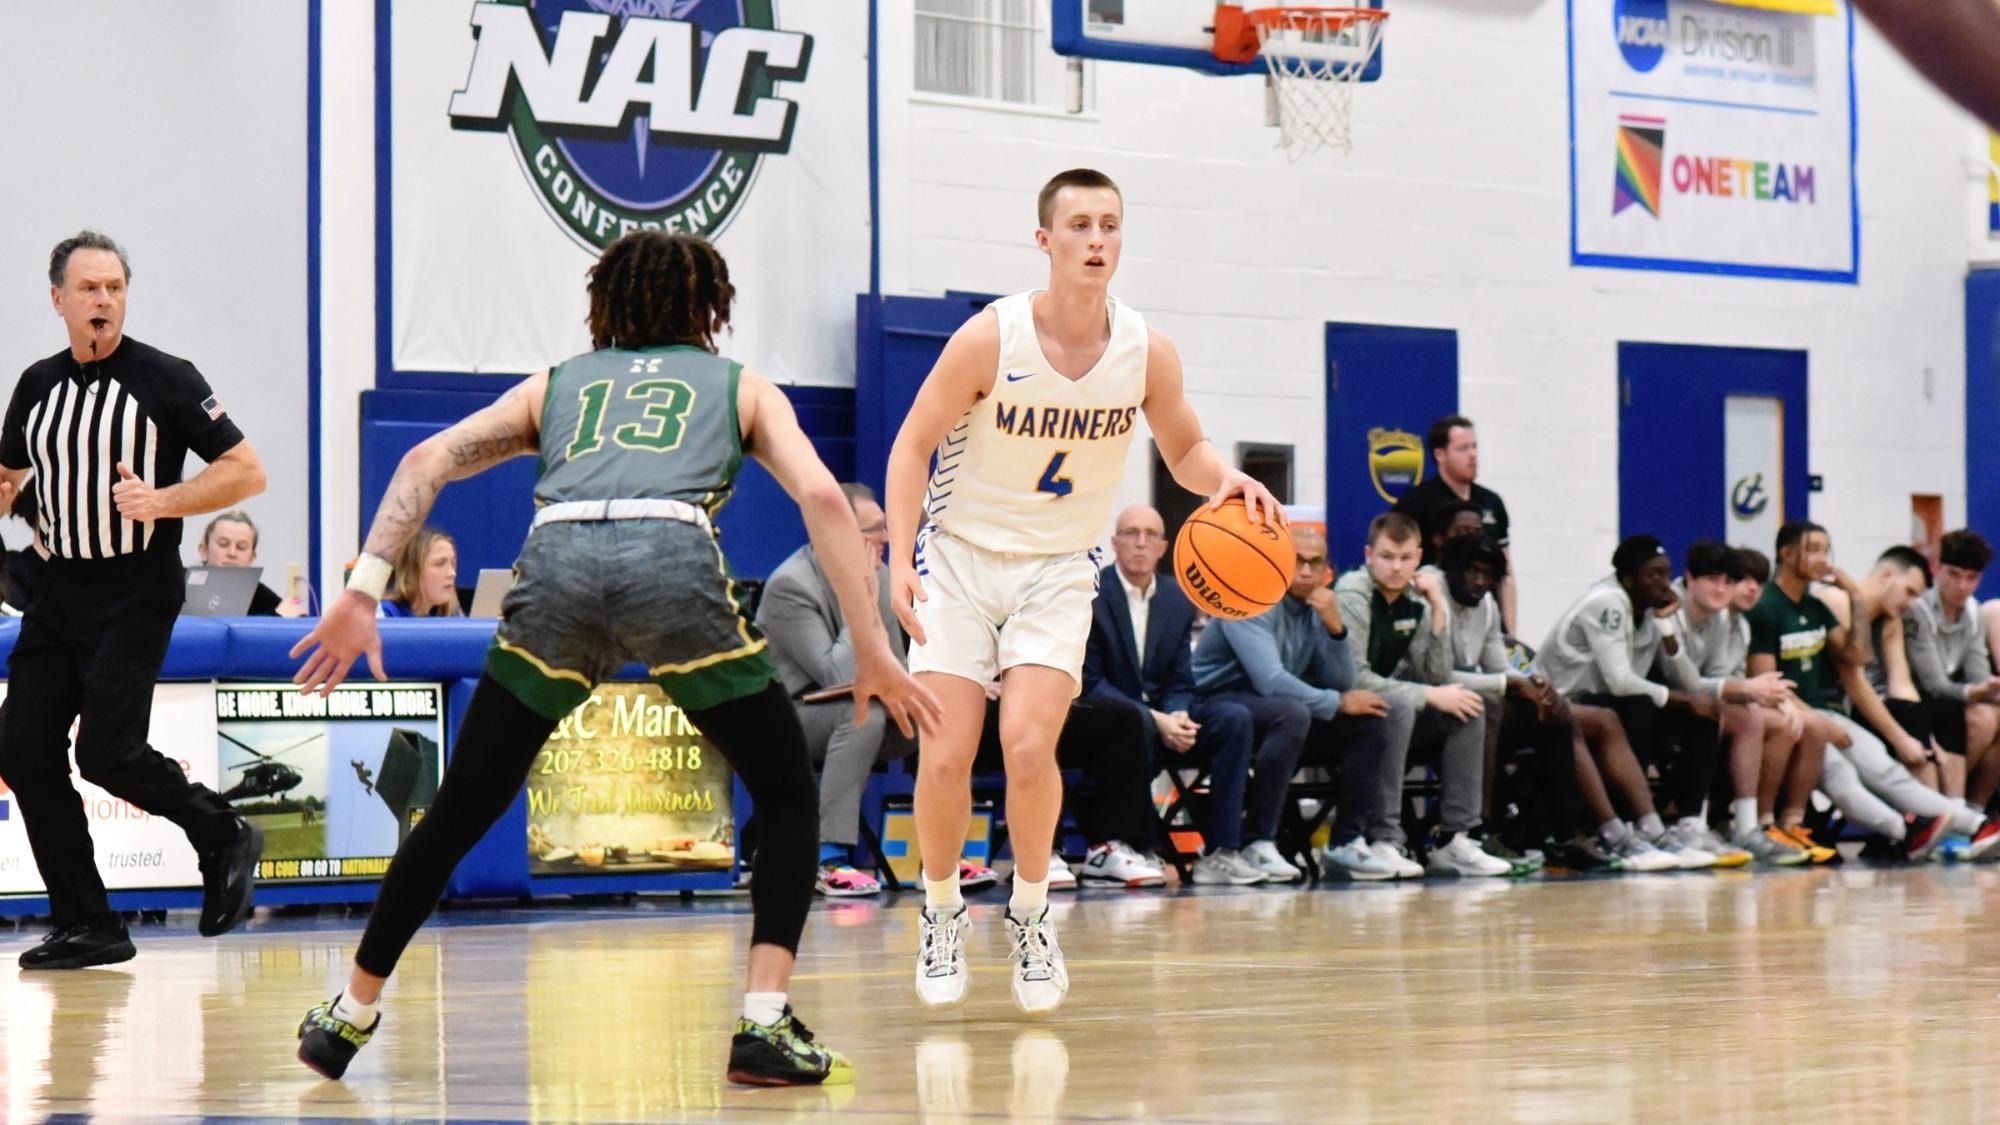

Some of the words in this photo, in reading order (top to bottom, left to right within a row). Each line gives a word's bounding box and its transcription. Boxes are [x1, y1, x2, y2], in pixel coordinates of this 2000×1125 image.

[1680, 14, 1772, 64] Division
[1777, 25, 1797, 67] III
[448, 1, 813, 154] NAC
[1672, 153, 1816, 204] ONETEAM
[566, 378, 697, 462] 13
[996, 401, 1137, 440] MARINERS
[1033, 449, 1074, 500] 4
[1185, 561, 1249, 617] Wilson
[1600, 608, 1622, 631] 43
[218, 692, 237, 717] BE
[372, 691, 393, 716] DO
[541, 746, 702, 775] 207-326-4818
[527, 787, 559, 817] We
[621, 787, 715, 816] Mariners
[109, 849, 166, 869] trusted.
[261, 861, 274, 880] QR
[275, 861, 299, 878] CODE
[300, 860, 314, 877] OR
[314, 860, 328, 876] GO
[329, 859, 341, 876] TO
